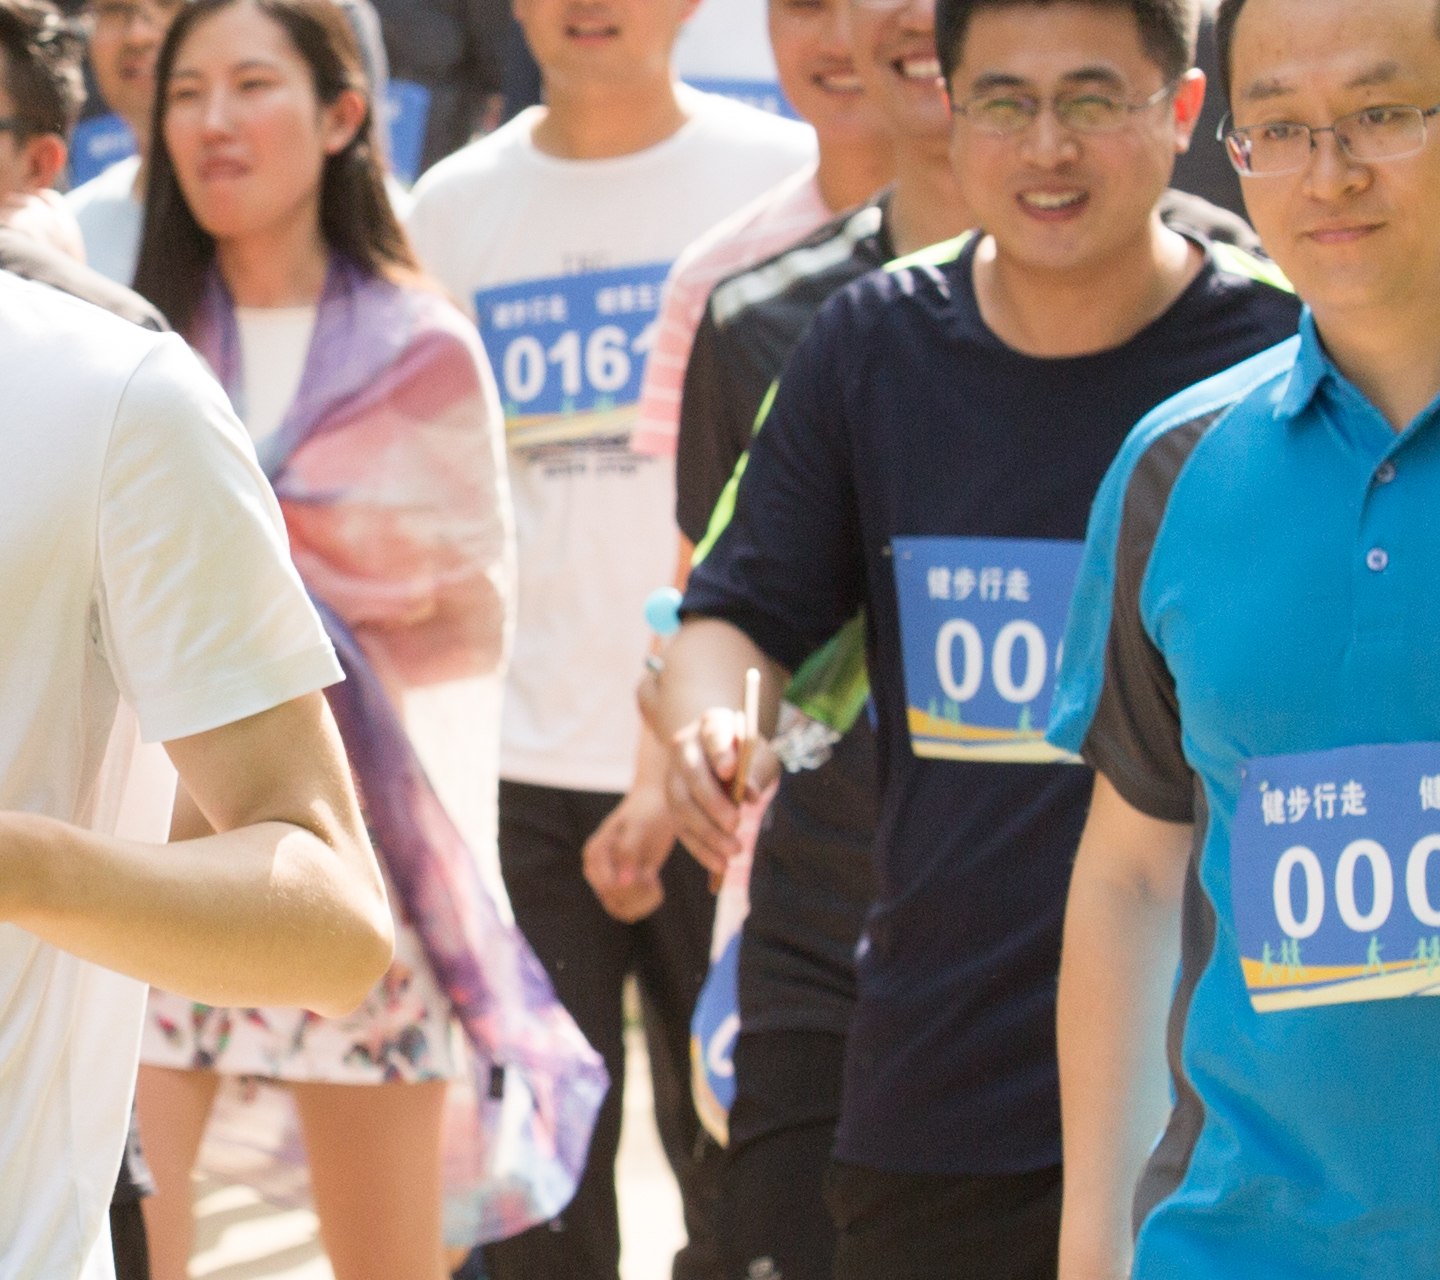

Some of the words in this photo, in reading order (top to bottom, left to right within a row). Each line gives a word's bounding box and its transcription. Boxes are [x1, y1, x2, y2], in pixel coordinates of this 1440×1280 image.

[935, 618, 1065, 703] 00
[1261, 779, 1368, 826] 健步行走
